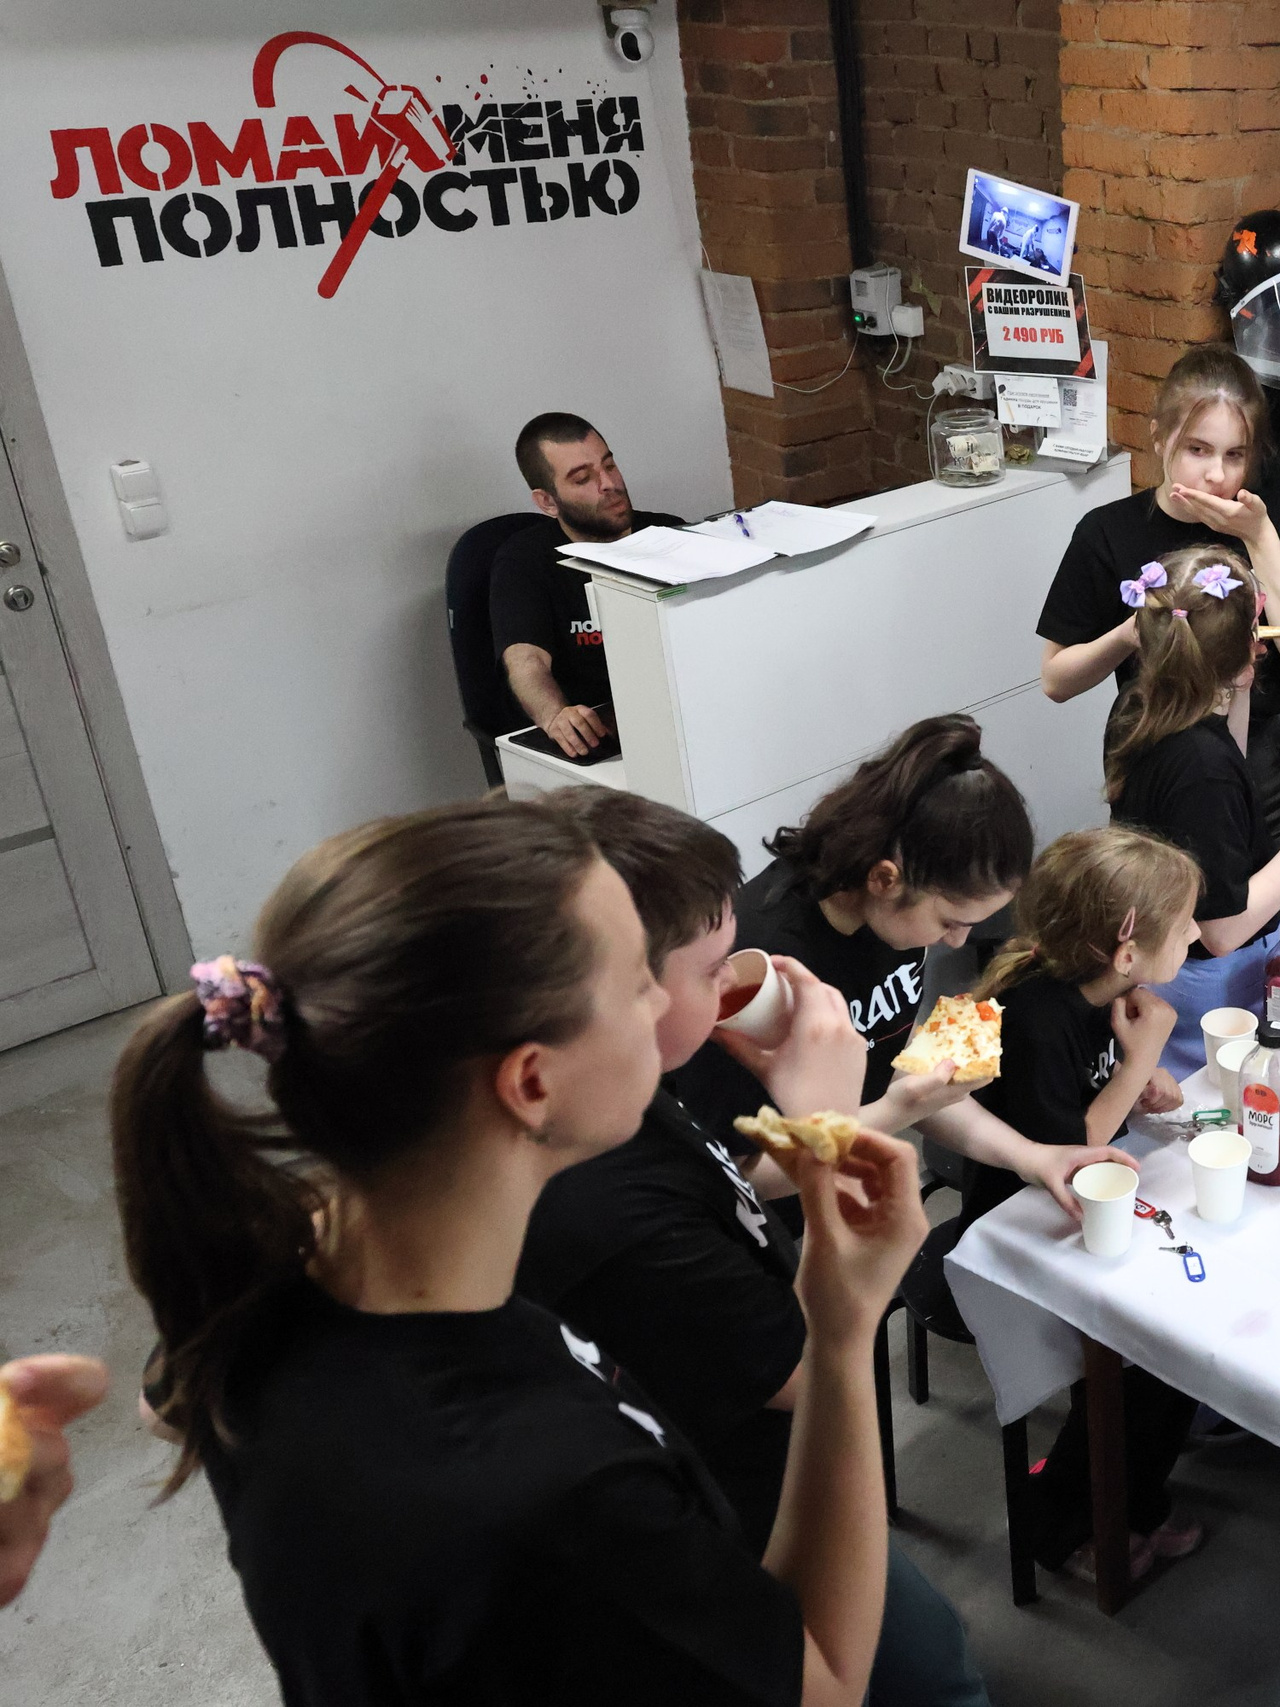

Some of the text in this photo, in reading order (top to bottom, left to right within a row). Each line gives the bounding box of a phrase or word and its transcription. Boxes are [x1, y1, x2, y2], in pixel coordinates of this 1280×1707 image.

[442, 96, 645, 166] МЕНЯ
[85, 159, 640, 267] ПОЛНОСТЬЮ
[986, 288, 1069, 306] ВИДЕОРОЛИК
[987, 305, 1071, 318] С ВАШИМ РАЗРУШЕНИЕМ
[1002, 326, 1064, 344] 2 490 РУБ
[1248, 1110, 1274, 1126] МОРС
